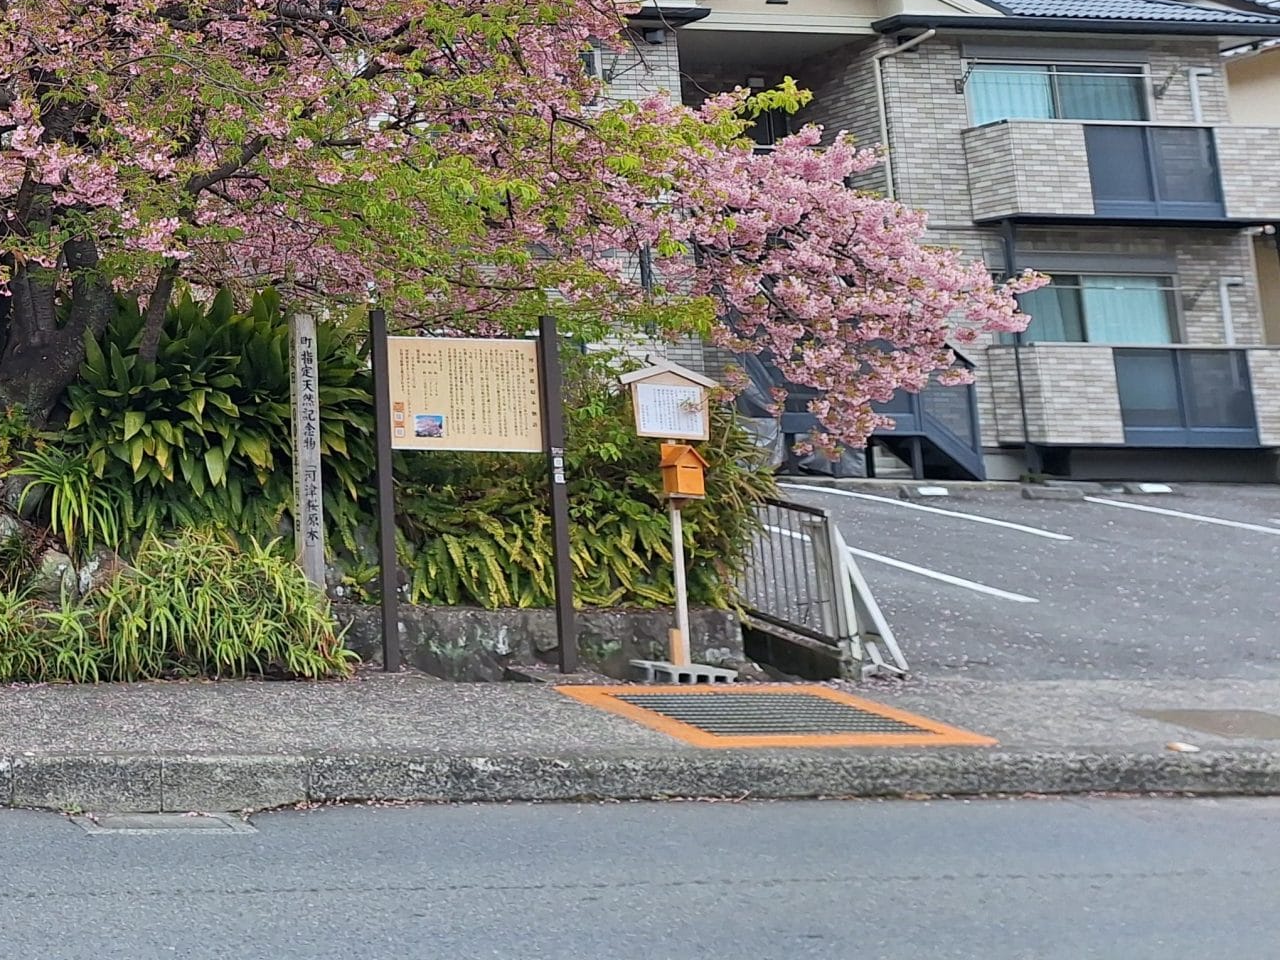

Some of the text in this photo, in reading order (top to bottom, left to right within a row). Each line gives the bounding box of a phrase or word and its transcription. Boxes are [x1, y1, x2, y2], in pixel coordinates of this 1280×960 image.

[300, 336, 316, 450] 町指定天然記念物
